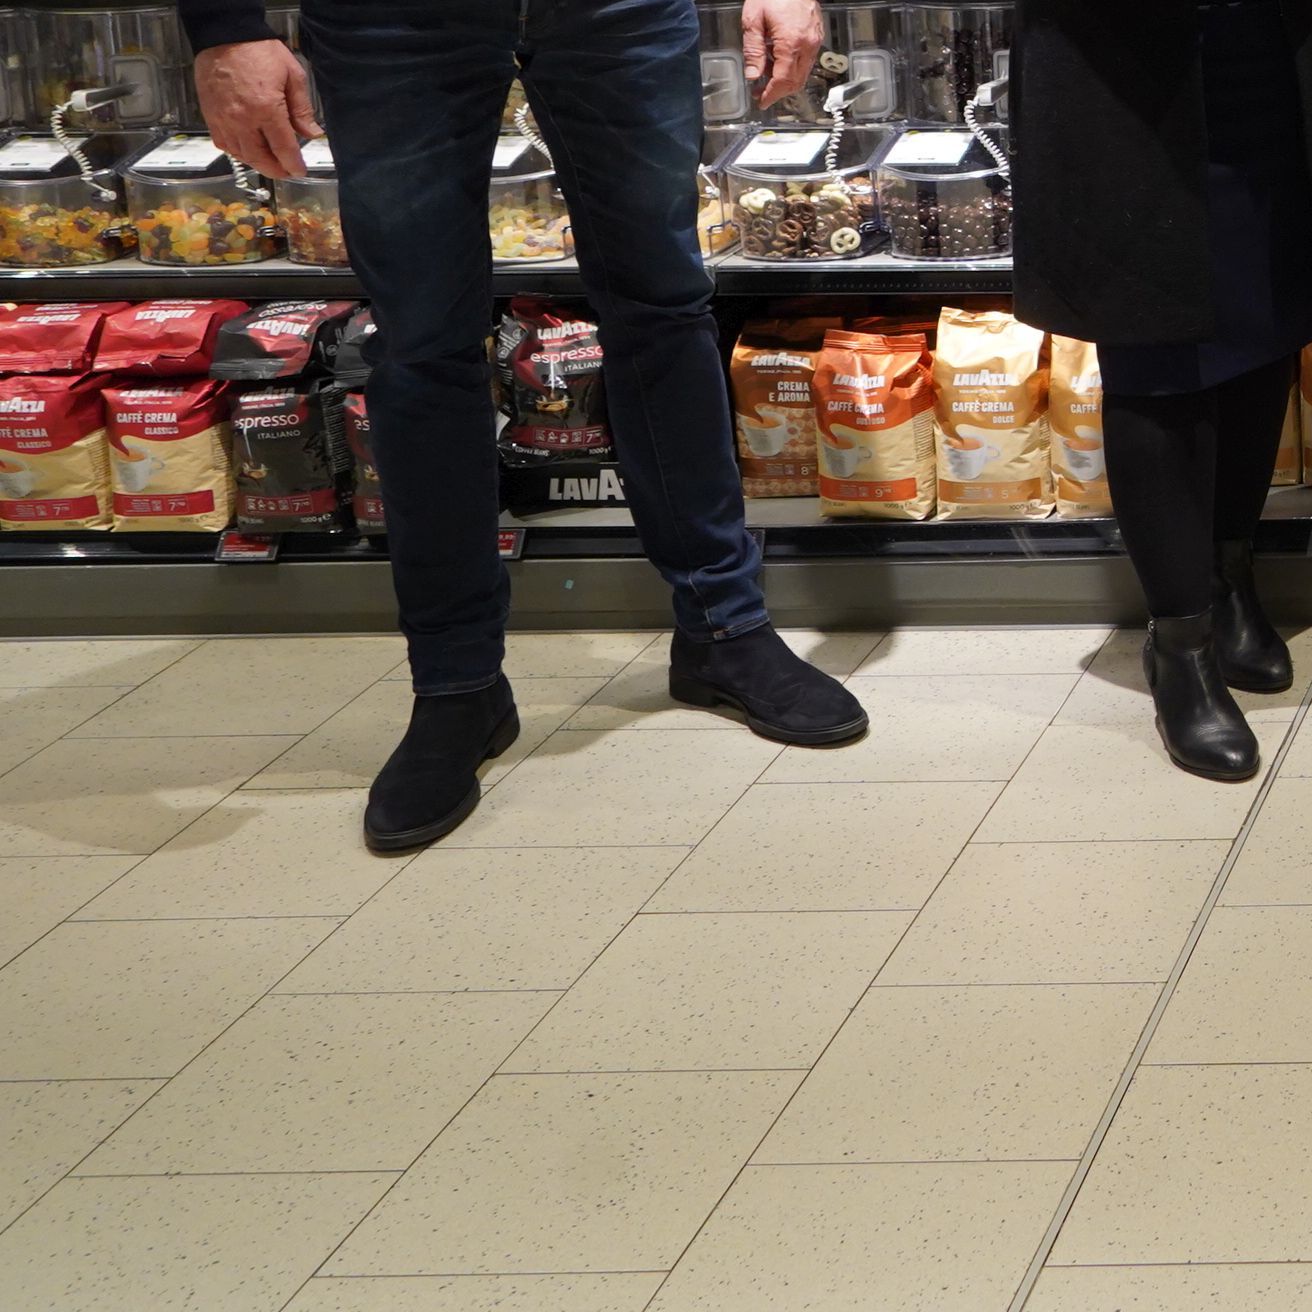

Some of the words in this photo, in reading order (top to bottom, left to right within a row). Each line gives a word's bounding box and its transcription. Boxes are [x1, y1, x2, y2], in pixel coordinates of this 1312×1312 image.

[537, 321, 599, 341] LAVAZZA
[751, 352, 811, 367] LAVAZZA
[565, 361, 602, 372] ITALIAN
[833, 373, 886, 388] LAVAZZA
[953, 369, 1017, 386] LAVAZZA
[777, 381, 810, 392] CREMA
[769, 392, 775, 402] E
[777, 392, 811, 403] AROMA
[854, 401, 884, 413] CREMA
[952, 399, 981, 412] CAFFÈ
[981, 401, 1014, 412] CREMA
[116, 413, 143, 424] CAFFÈ
[144, 413, 177, 423] CREMA
[992, 415, 1015, 424] DOLCE
[14, 428, 48, 438] CREMA
[144, 426, 179, 435] CLASSICO
[257, 429, 301, 440] ITALIANO
[17, 441, 52, 449] CLASSICO
[549, 469, 625, 501] LAVA
